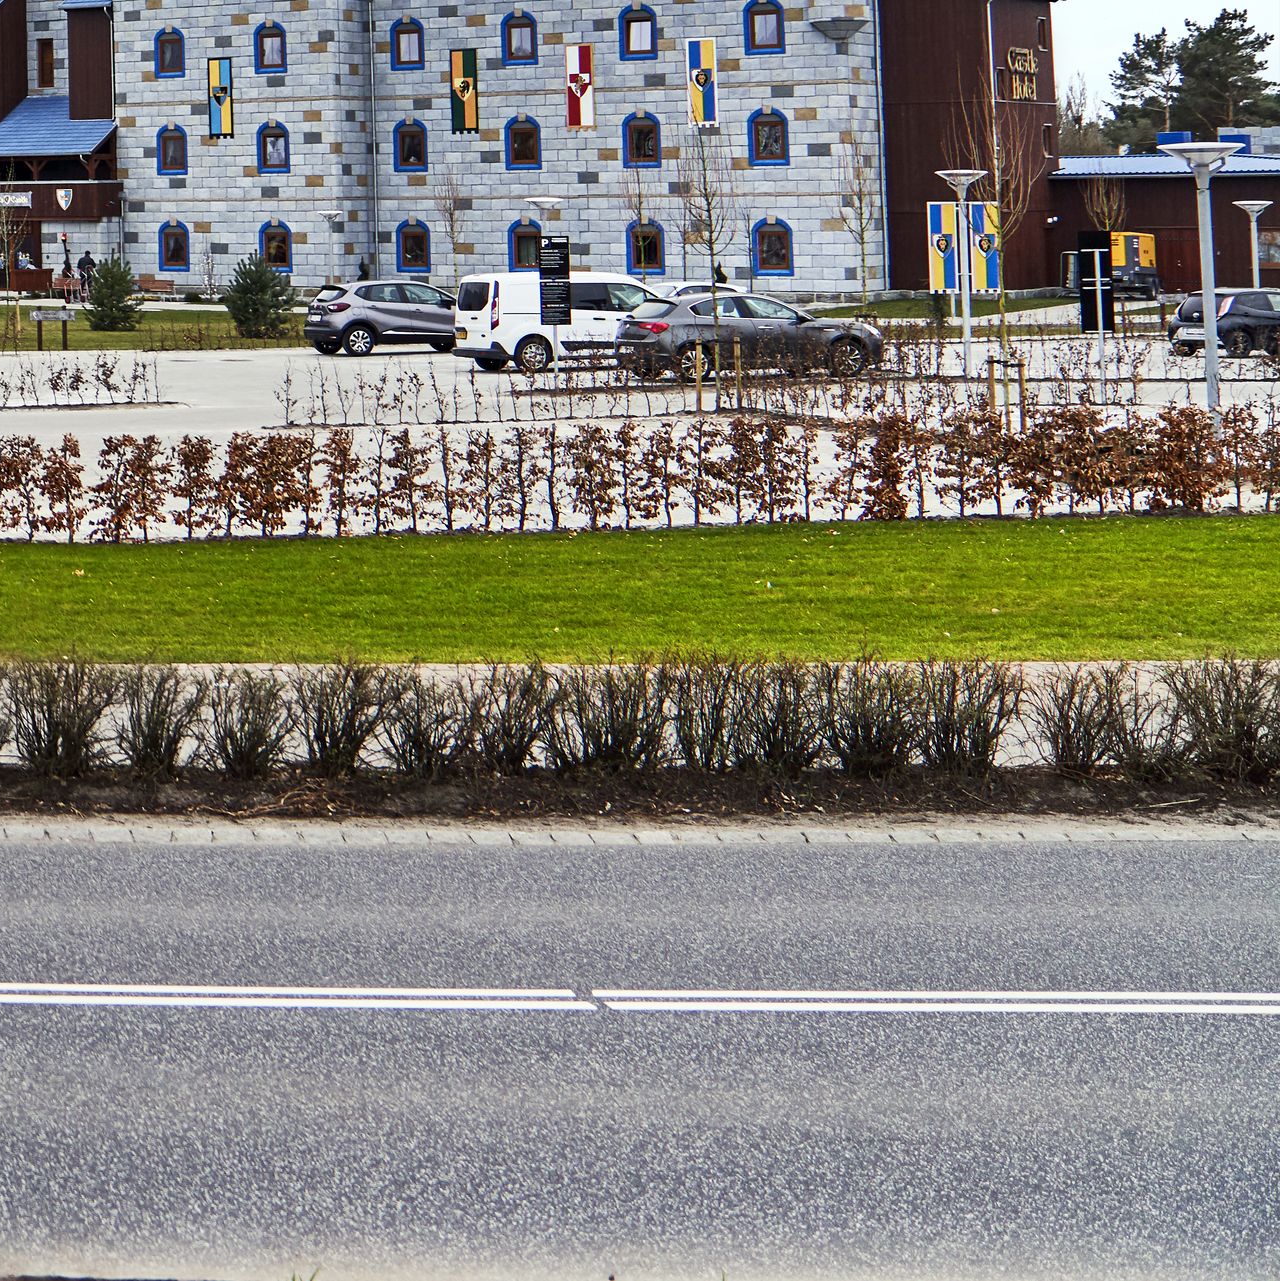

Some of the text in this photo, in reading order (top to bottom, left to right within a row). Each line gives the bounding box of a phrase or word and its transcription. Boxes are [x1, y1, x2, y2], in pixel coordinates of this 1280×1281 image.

[1007, 47, 1038, 73] Castle
[1012, 74, 1037, 100] Hotel
[541, 238, 549, 247] P
